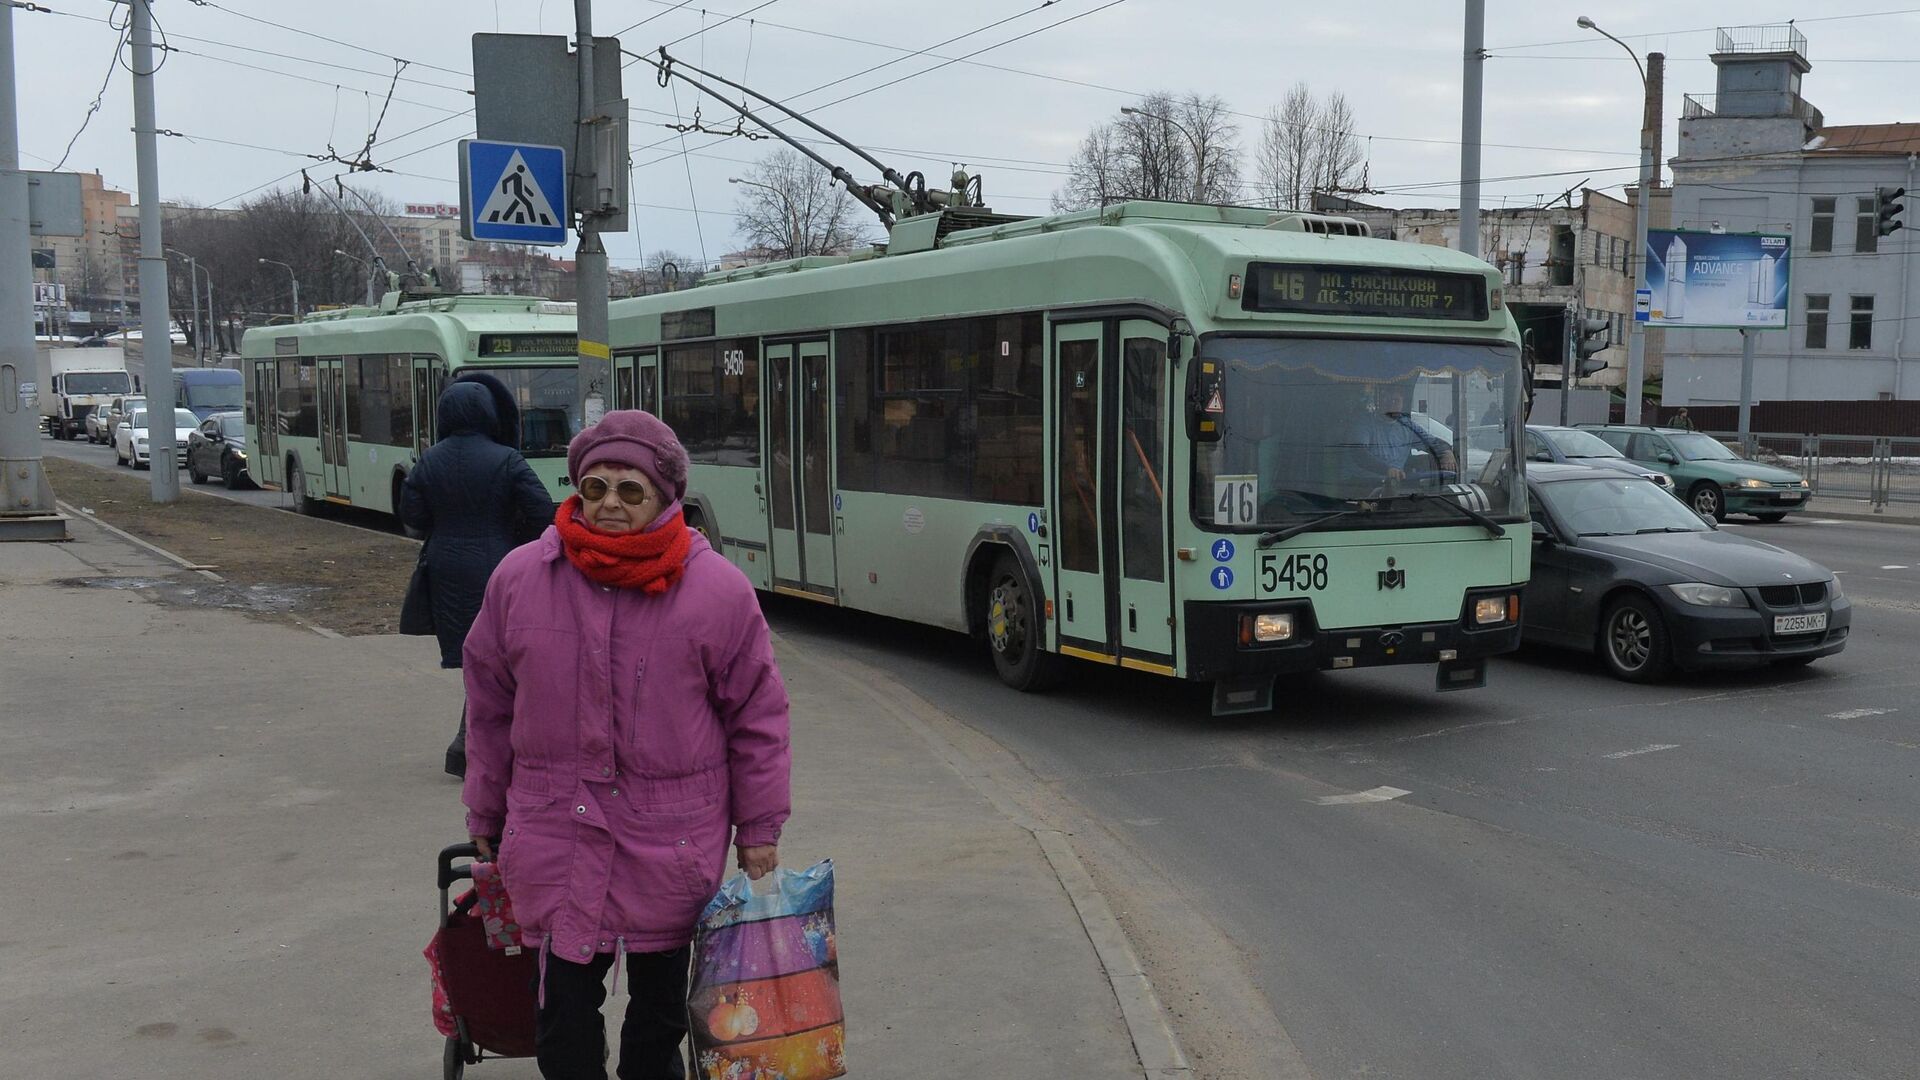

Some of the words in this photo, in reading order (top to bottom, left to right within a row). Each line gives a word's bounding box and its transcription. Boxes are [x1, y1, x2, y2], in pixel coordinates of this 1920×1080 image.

[1693, 262, 1743, 274] ADVANCE
[1272, 271, 1305, 301] 46
[1443, 295, 1454, 309] 7
[493, 338, 513, 353] 29
[724, 349, 744, 376] 5458
[1218, 482, 1254, 524] 46
[1261, 553, 1328, 593] 5458
[1784, 617, 1806, 631] 2255
